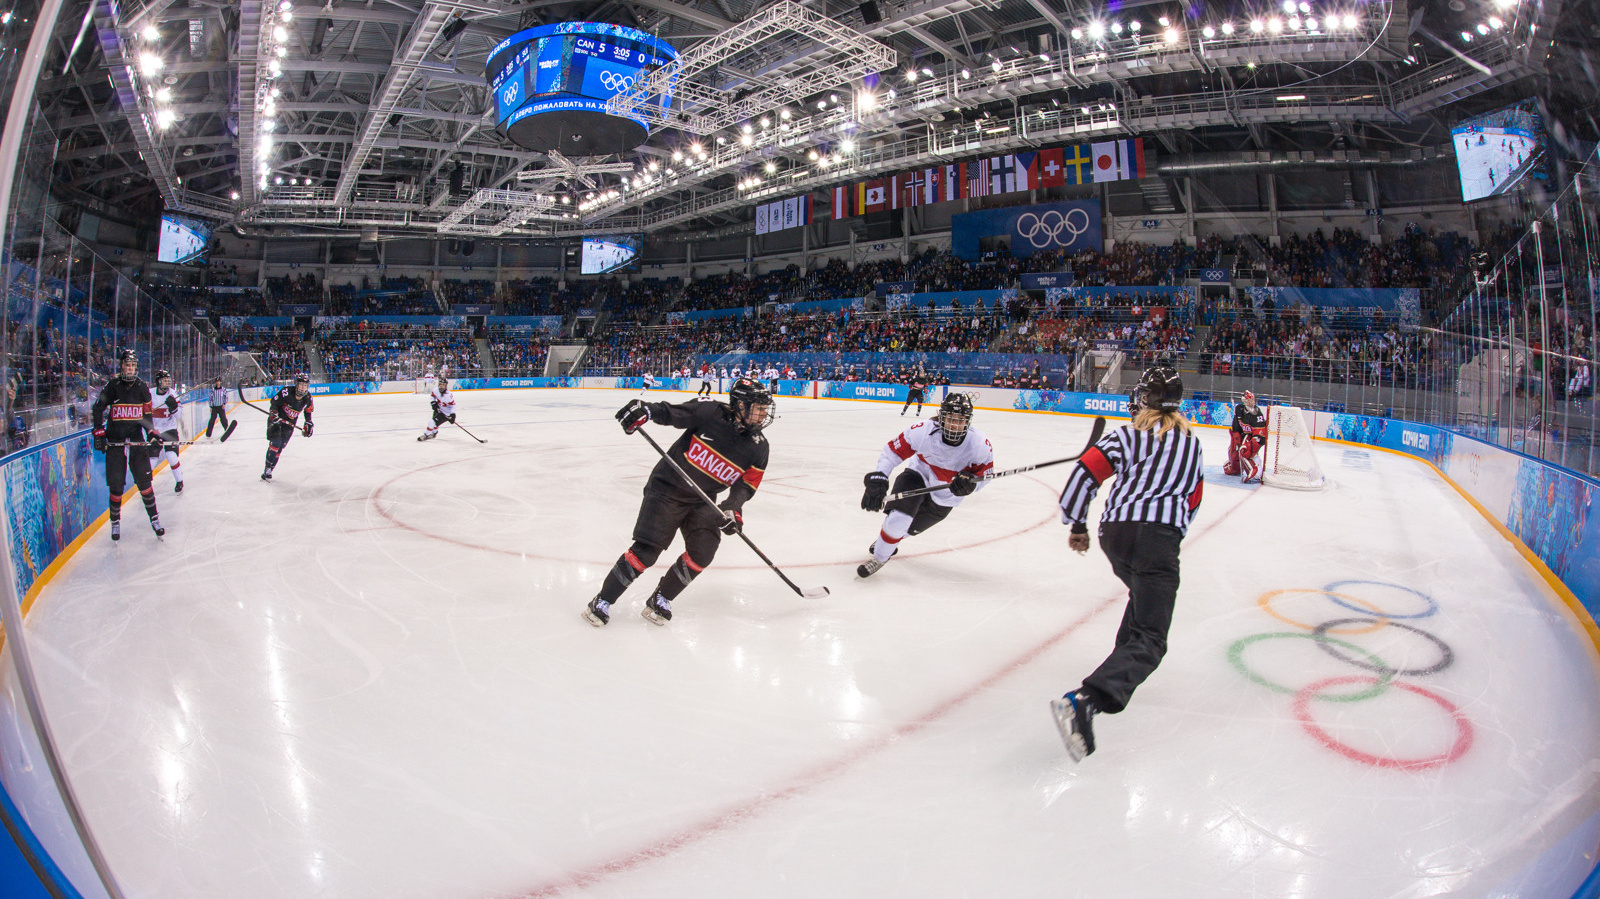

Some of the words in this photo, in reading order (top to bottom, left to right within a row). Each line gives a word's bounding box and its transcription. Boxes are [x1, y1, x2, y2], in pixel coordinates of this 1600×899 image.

[493, 38, 511, 55] GAMES
[577, 39, 595, 50] CAN
[598, 42, 606, 53] 5
[613, 46, 631, 58] 3:05
[638, 53, 645, 63] 0
[500, 70, 504, 80] 5
[533, 101, 583, 112] ПОЖАЛОВАТЬ
[585, 101, 597, 109] НА
[855, 386, 876, 396] СОЧИ
[876, 387, 895, 397] 2014
[112, 406, 143, 418] CANADA
[1084, 398, 1117, 412] SOCHI
[1402, 430, 1419, 448] СОЧИ
[1418, 432, 1430, 451] 2014
[688, 443, 741, 485] CANADA
